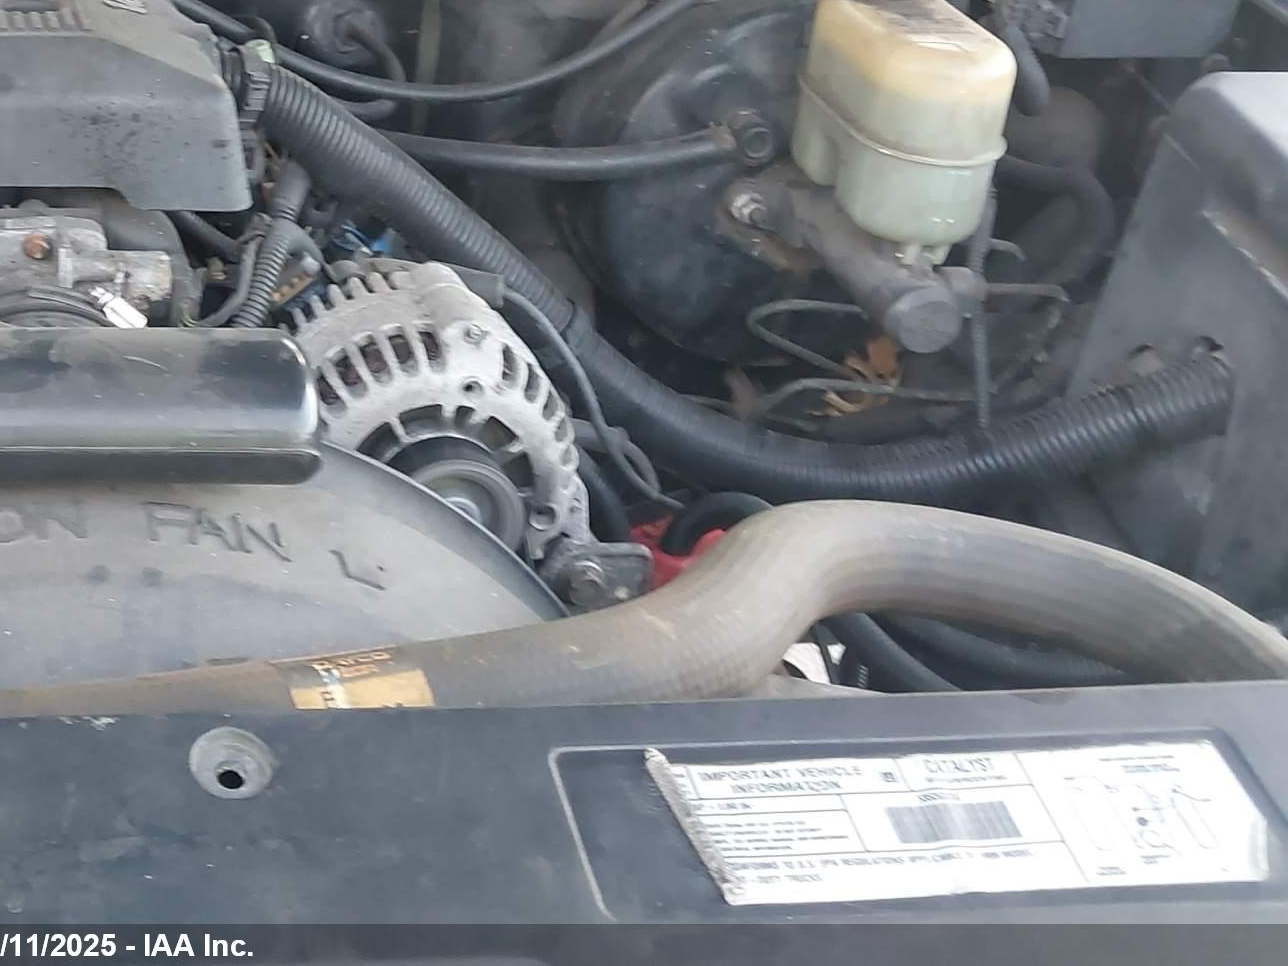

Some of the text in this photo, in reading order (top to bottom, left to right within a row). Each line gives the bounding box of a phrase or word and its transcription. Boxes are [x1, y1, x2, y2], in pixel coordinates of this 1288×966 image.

[143, 500, 292, 563] FAN
[699, 767, 790, 782] IMPORTANT
[795, 764, 863, 778] VEHICLE
[729, 779, 840, 794] INFORMATION
